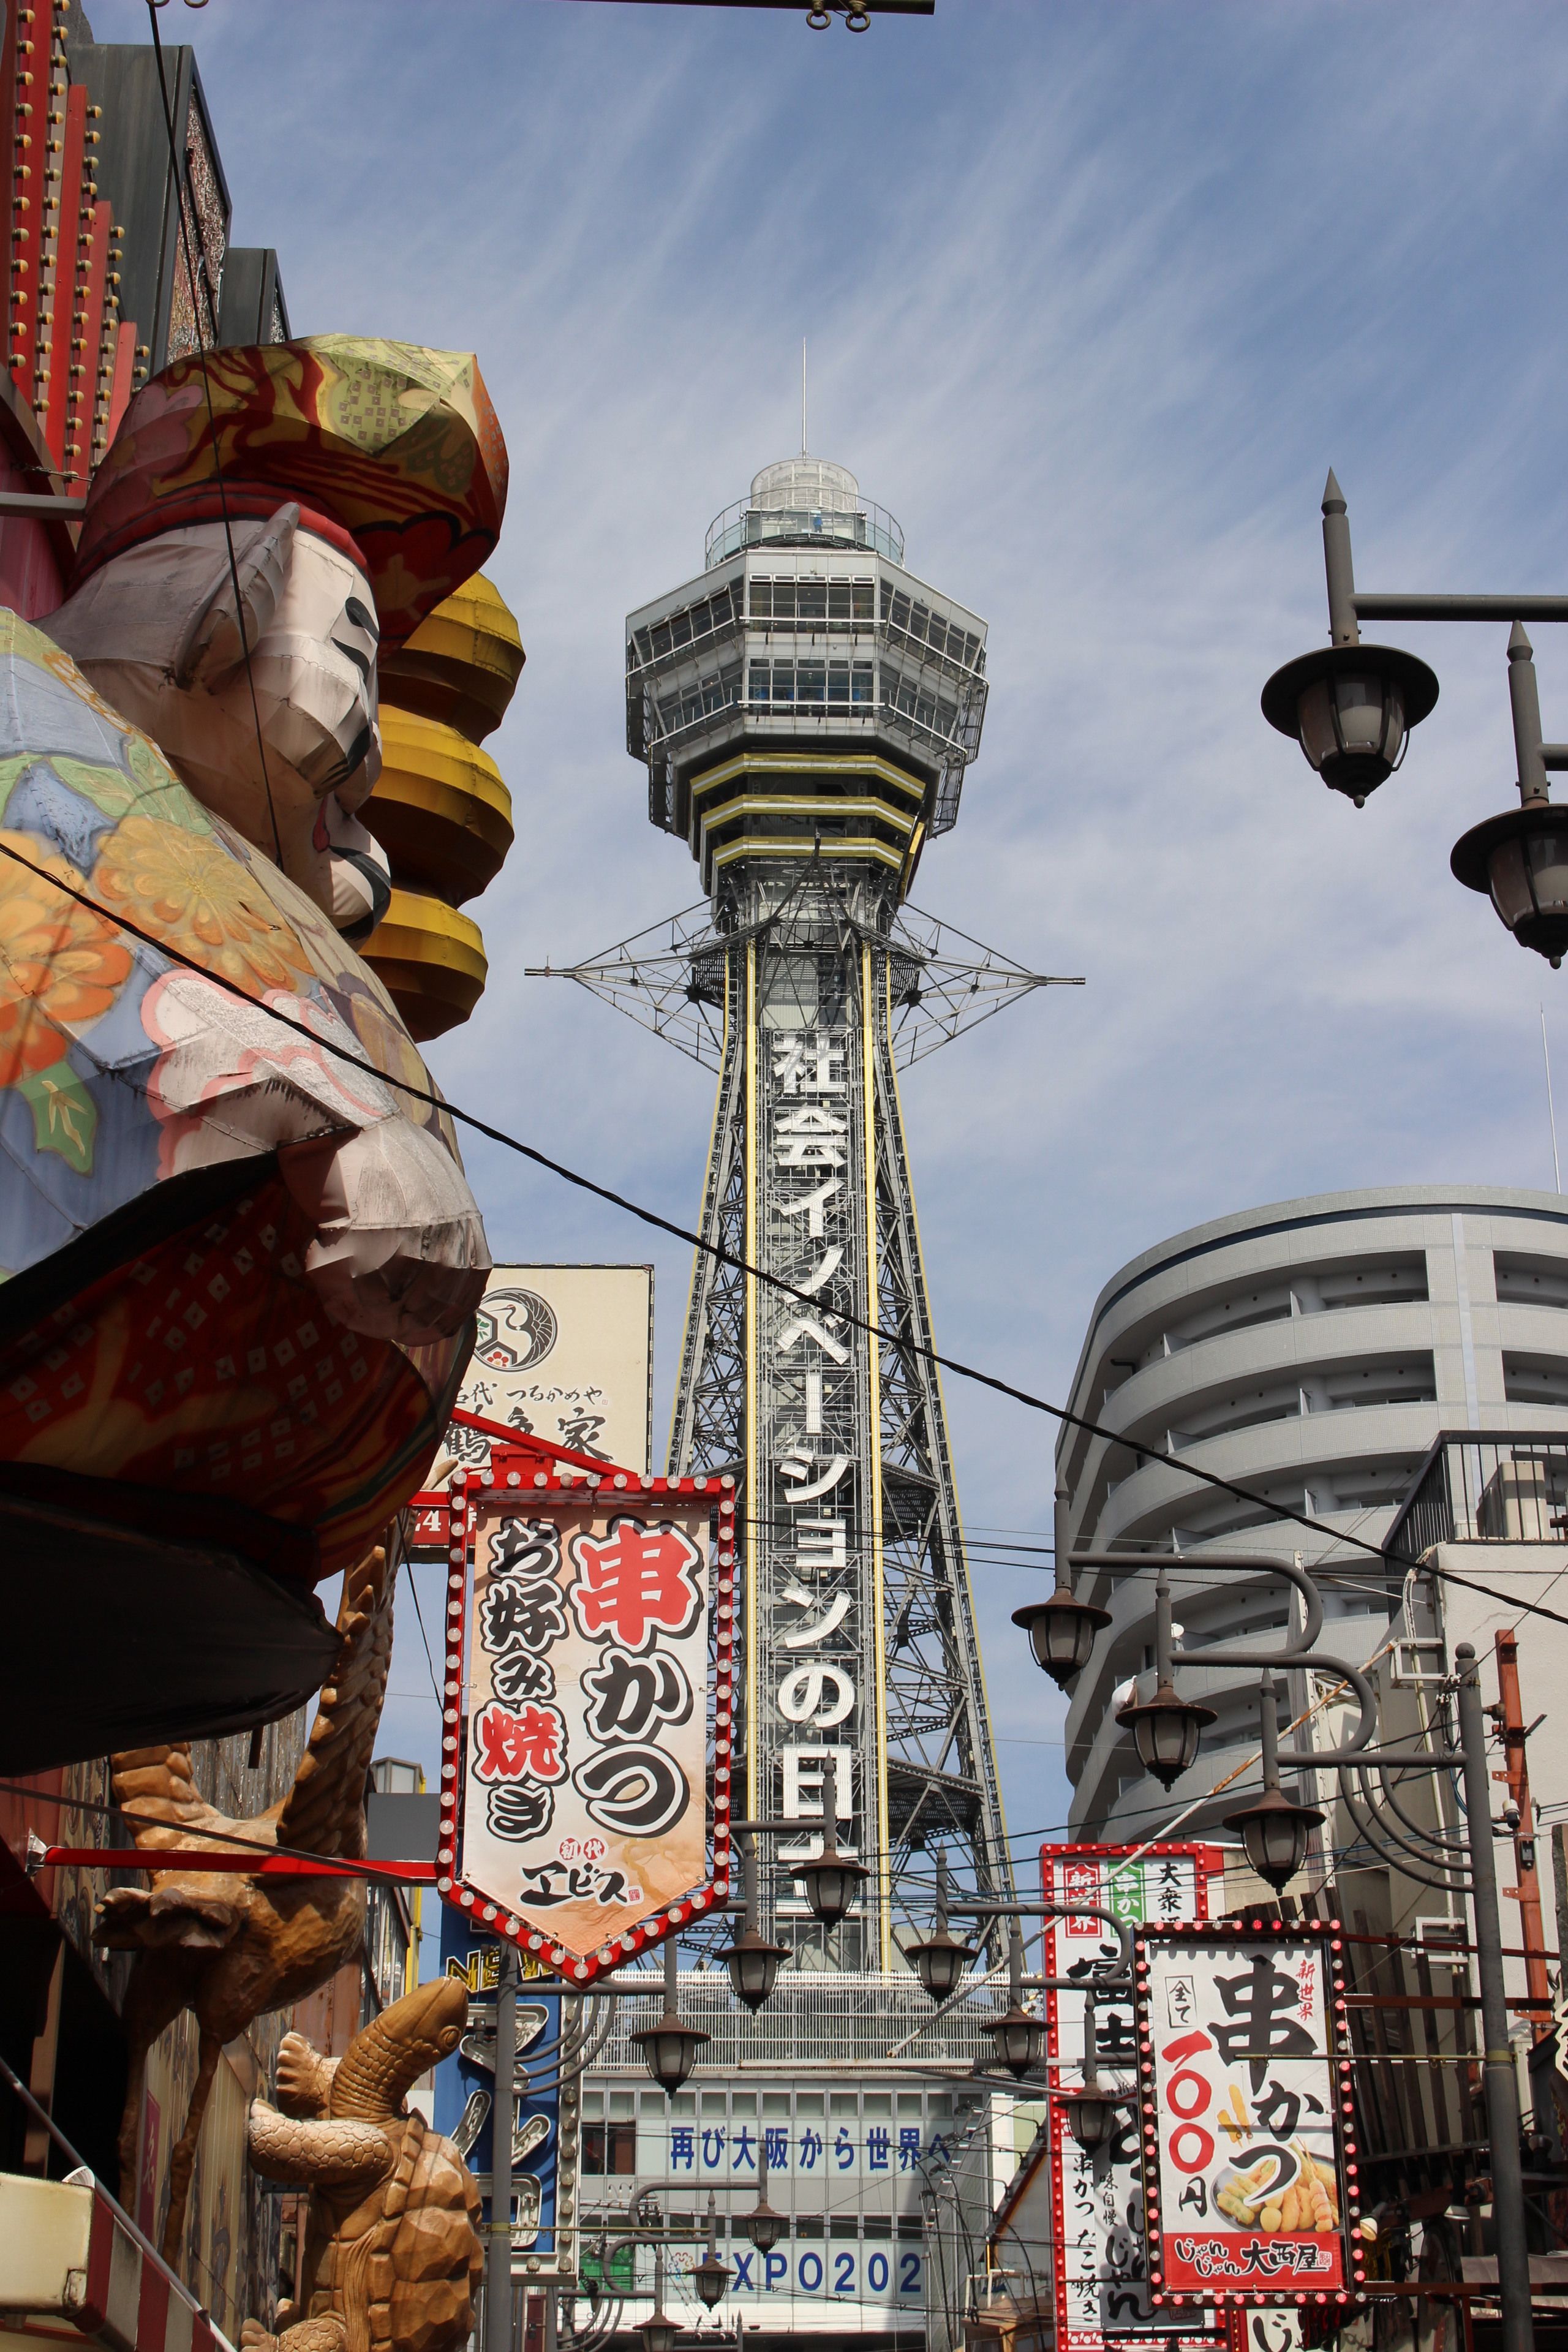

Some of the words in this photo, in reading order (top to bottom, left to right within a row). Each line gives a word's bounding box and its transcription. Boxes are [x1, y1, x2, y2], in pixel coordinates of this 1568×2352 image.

[506, 1385, 603, 1405] つるかめや
[477, 1520, 564, 1836] お好み焼き
[572, 1520, 697, 1831] 串かつ
[559, 1838, 605, 1860] 初代
[1158, 1861, 1182, 1921] 大衆
[1169, 1980, 1192, 2023] 全て
[1295, 1959, 1316, 2021] 新世界
[1207, 1954, 1324, 2202] 串かつ
[1072, 2152, 1095, 2217] 串かつ
[1099, 2168, 1118, 2227] 味自慢
[703, 2252, 922, 2293] XPO202
[1174, 2237, 1229, 2263] じゃん
[1195, 2255, 1241, 2277] じゃん
[1239, 2238, 1329, 2276] 大西屋
